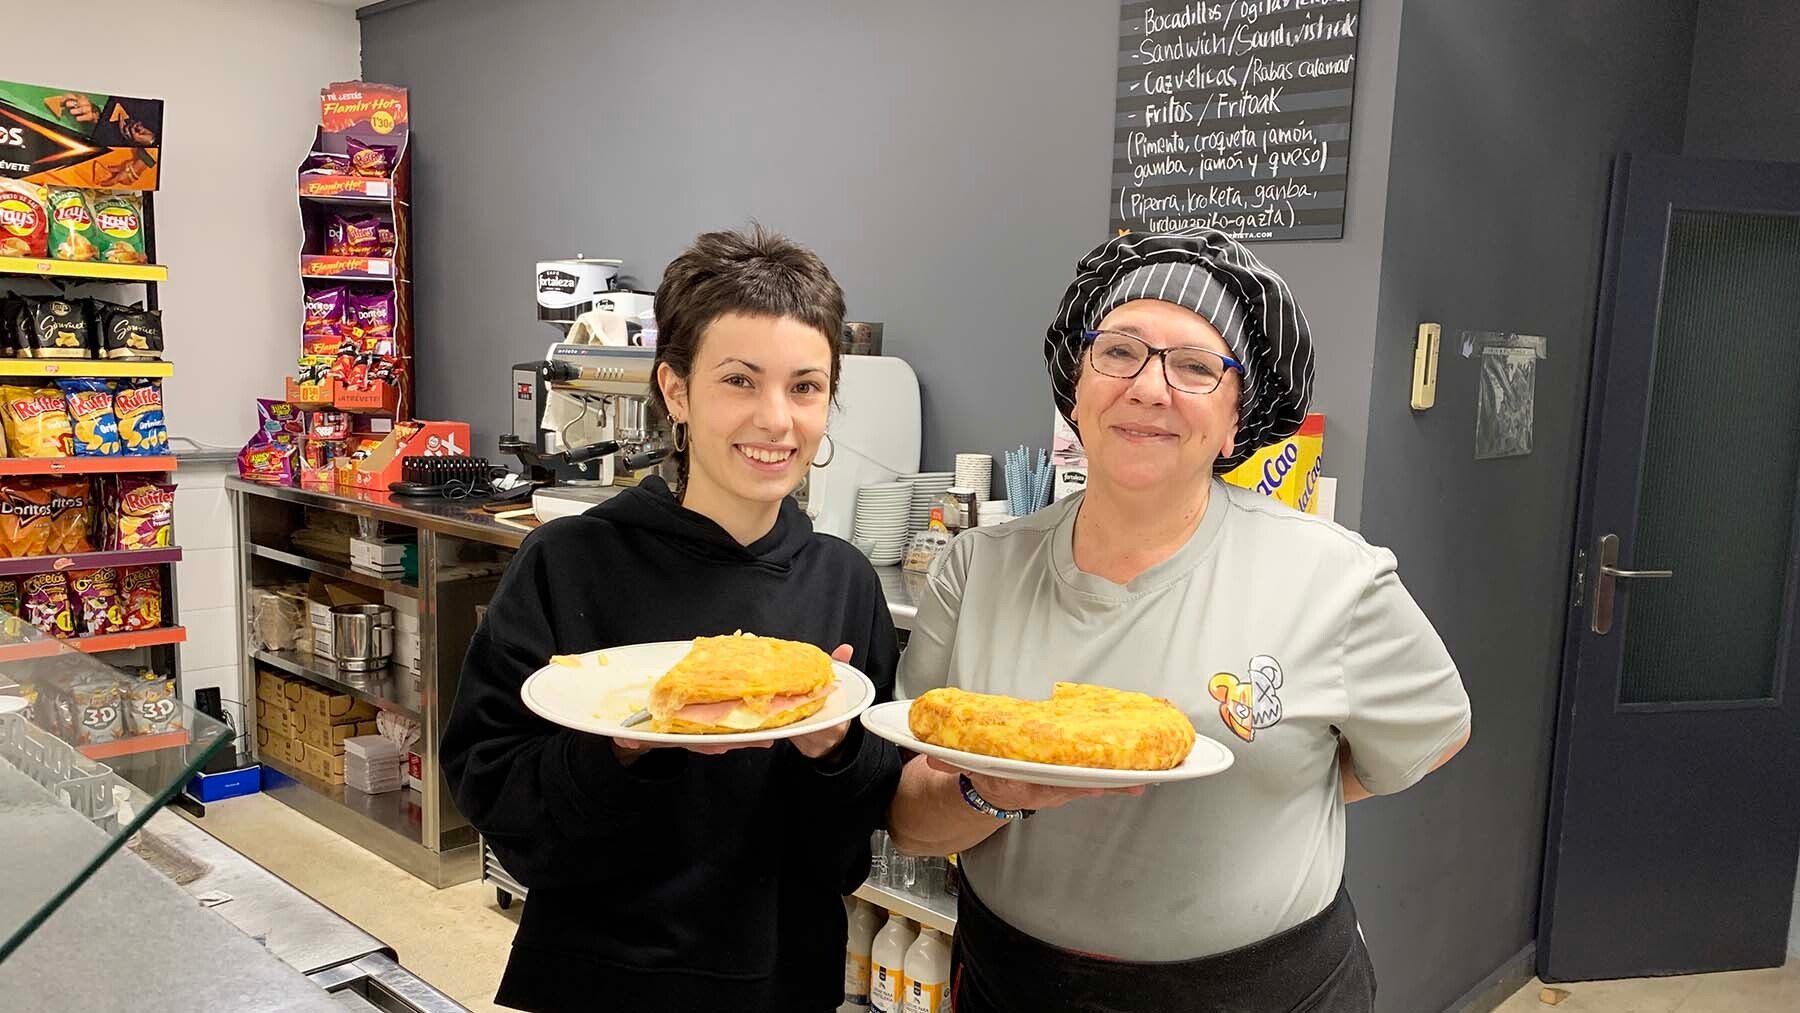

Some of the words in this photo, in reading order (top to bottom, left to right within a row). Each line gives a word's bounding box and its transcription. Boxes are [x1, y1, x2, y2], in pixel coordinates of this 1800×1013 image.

[1145, 97, 1193, 128] Fritos
[540, 274, 575, 289] fortaleza
[40, 315, 86, 341] Gourmet
[113, 319, 157, 340] Gourmet
[1, 501, 51, 516] Doritos
[52, 497, 84, 508] ritos
